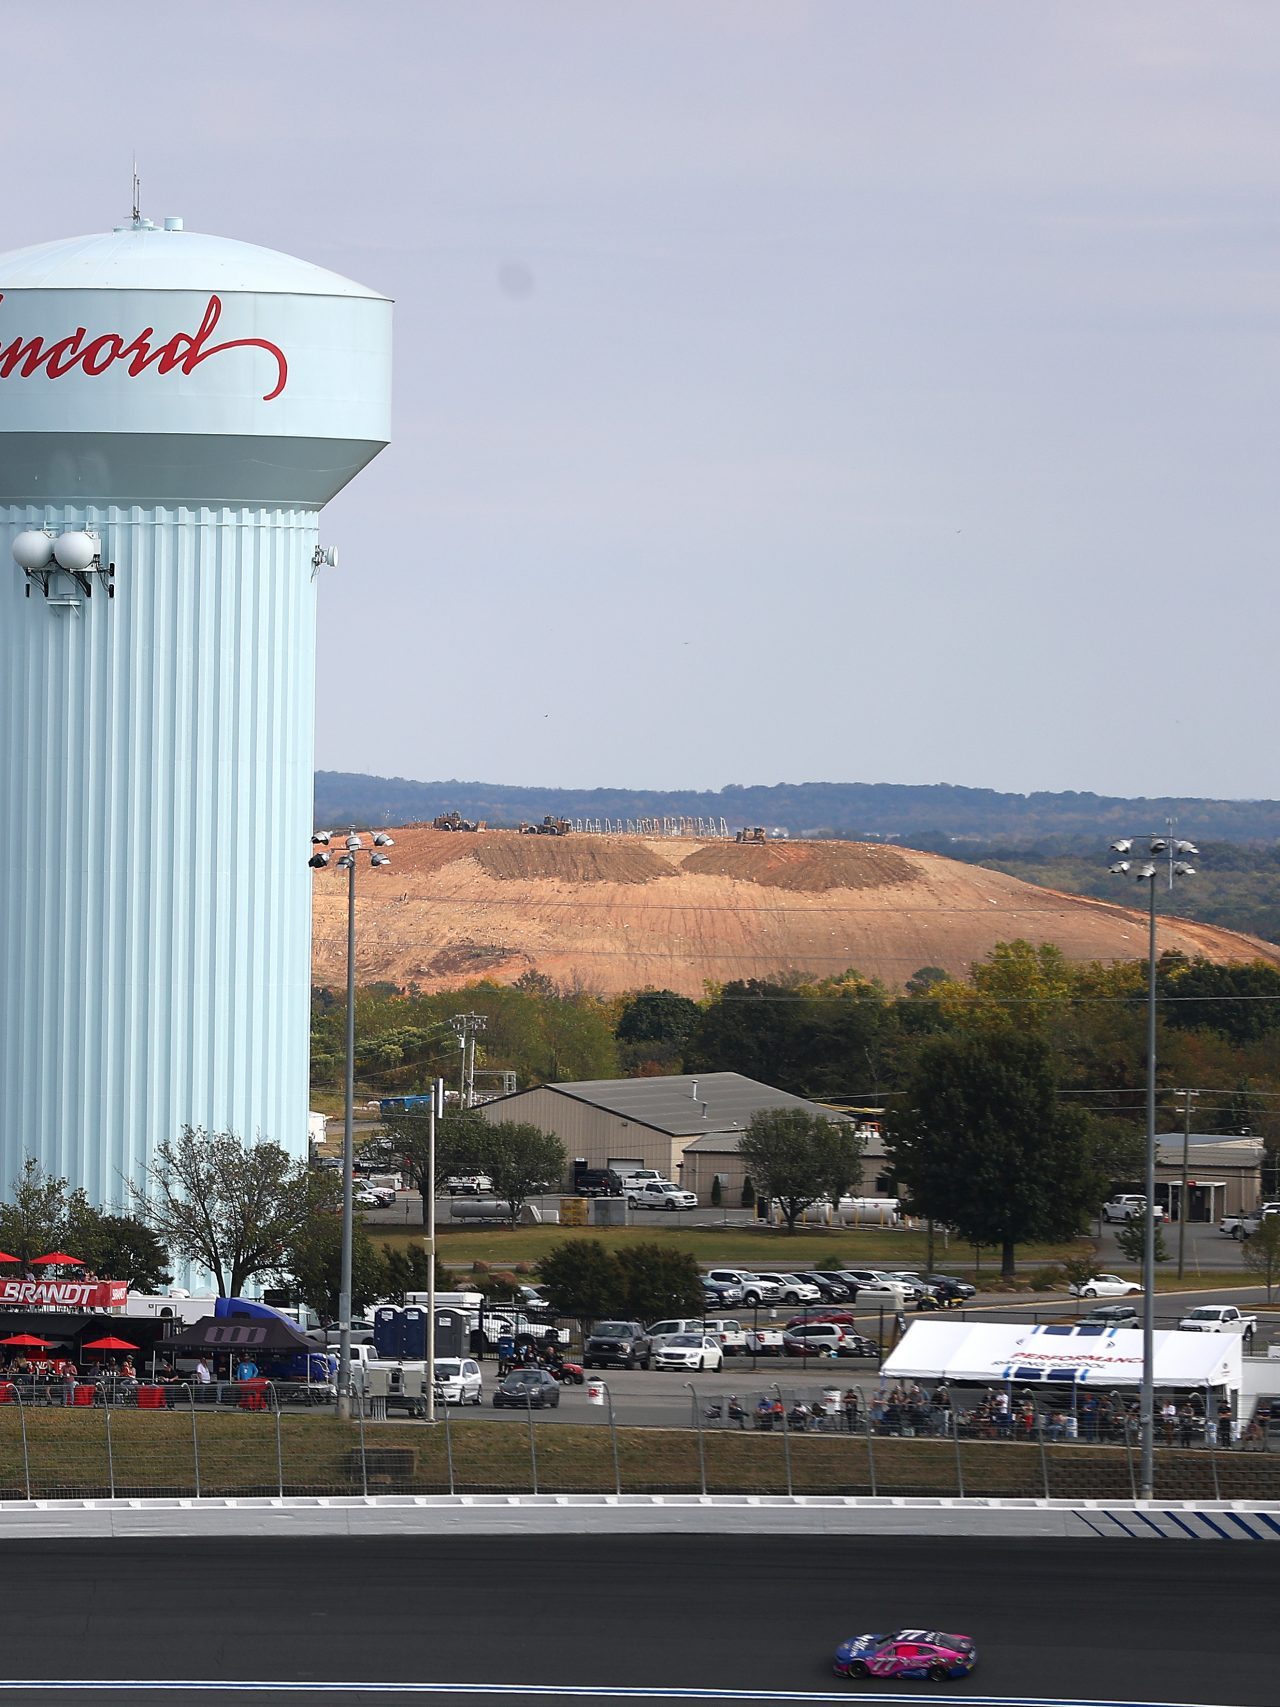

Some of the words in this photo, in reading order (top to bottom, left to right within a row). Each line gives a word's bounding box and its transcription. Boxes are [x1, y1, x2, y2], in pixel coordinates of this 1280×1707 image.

[0, 1282, 98, 1304] BRANDT
[1010, 1352, 1145, 1364] PERFORMANC
[1048, 1361, 1106, 1369] SCHOOL
[896, 1629, 929, 1640] 77
[872, 1657, 898, 1671] 77
